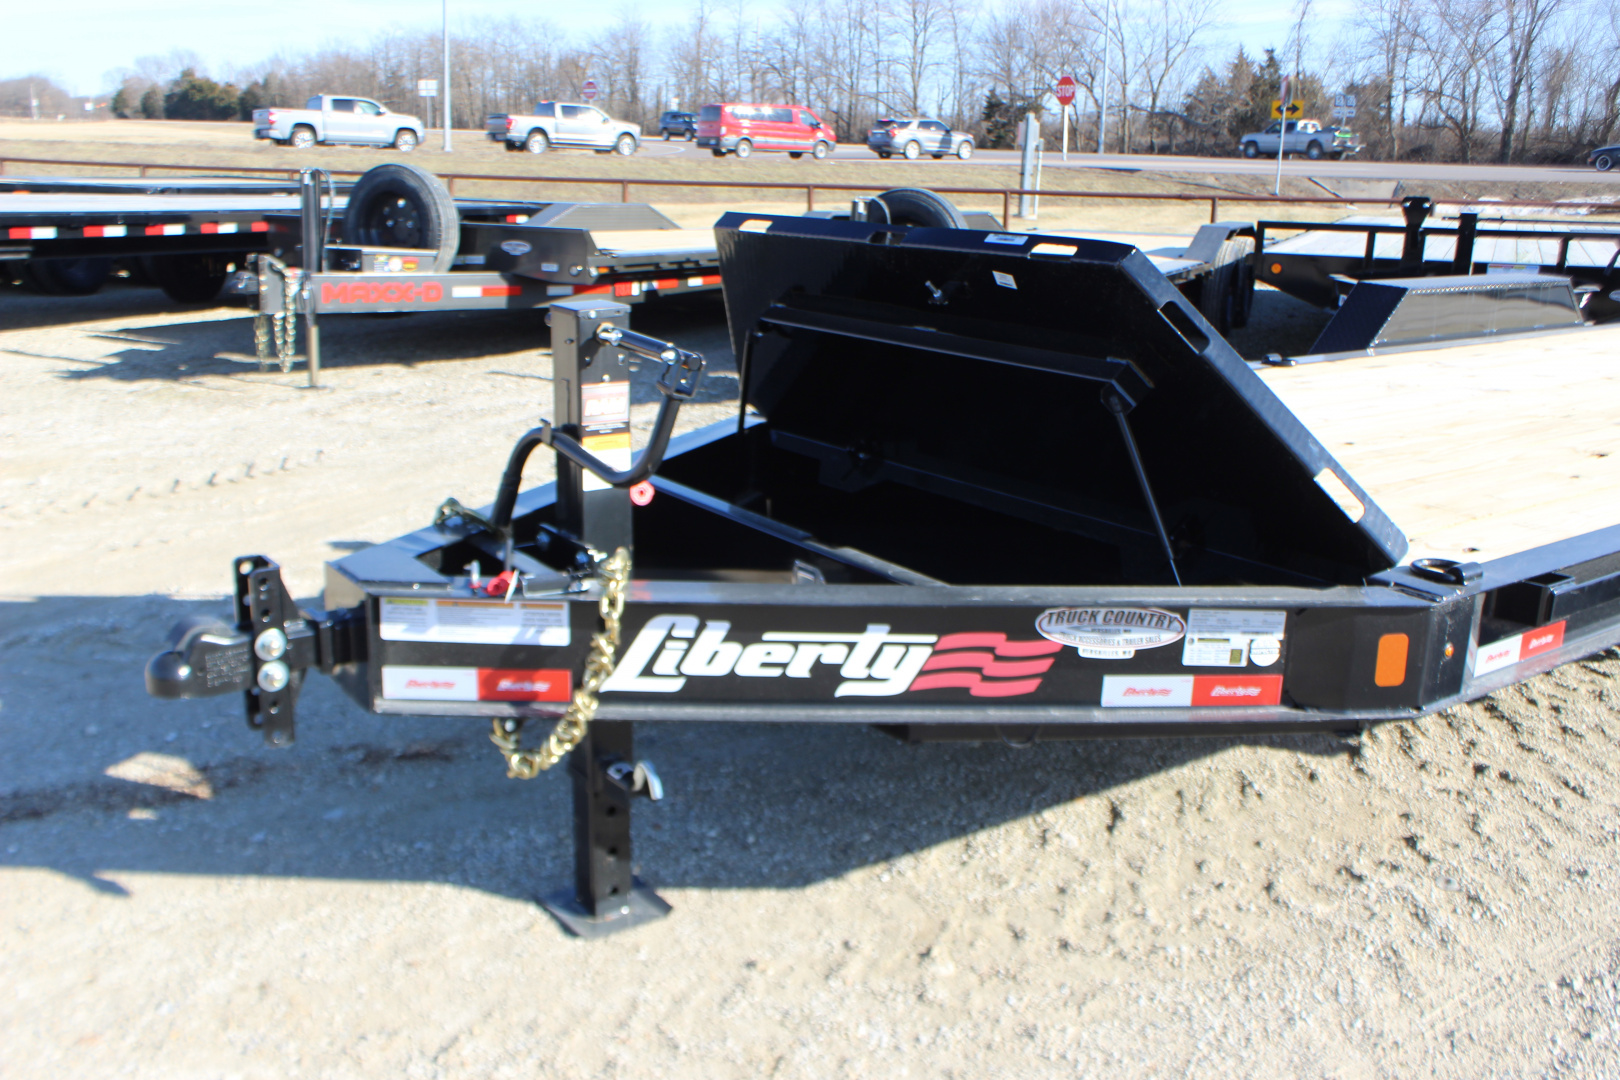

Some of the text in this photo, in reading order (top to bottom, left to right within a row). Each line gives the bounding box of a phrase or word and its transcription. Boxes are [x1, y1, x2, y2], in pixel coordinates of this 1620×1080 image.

[1056, 85, 1075, 97] STOP
[321, 281, 443, 304] MAXX-D
[1047, 610, 1100, 626] TRUCK
[1102, 610, 1178, 629] COUNTRY
[1078, 635, 1115, 646] ACCESSORIES
[1122, 636, 1143, 646] TRAILER
[1144, 634, 1162, 644] SALES
[600, 614, 938, 698] Liberty
